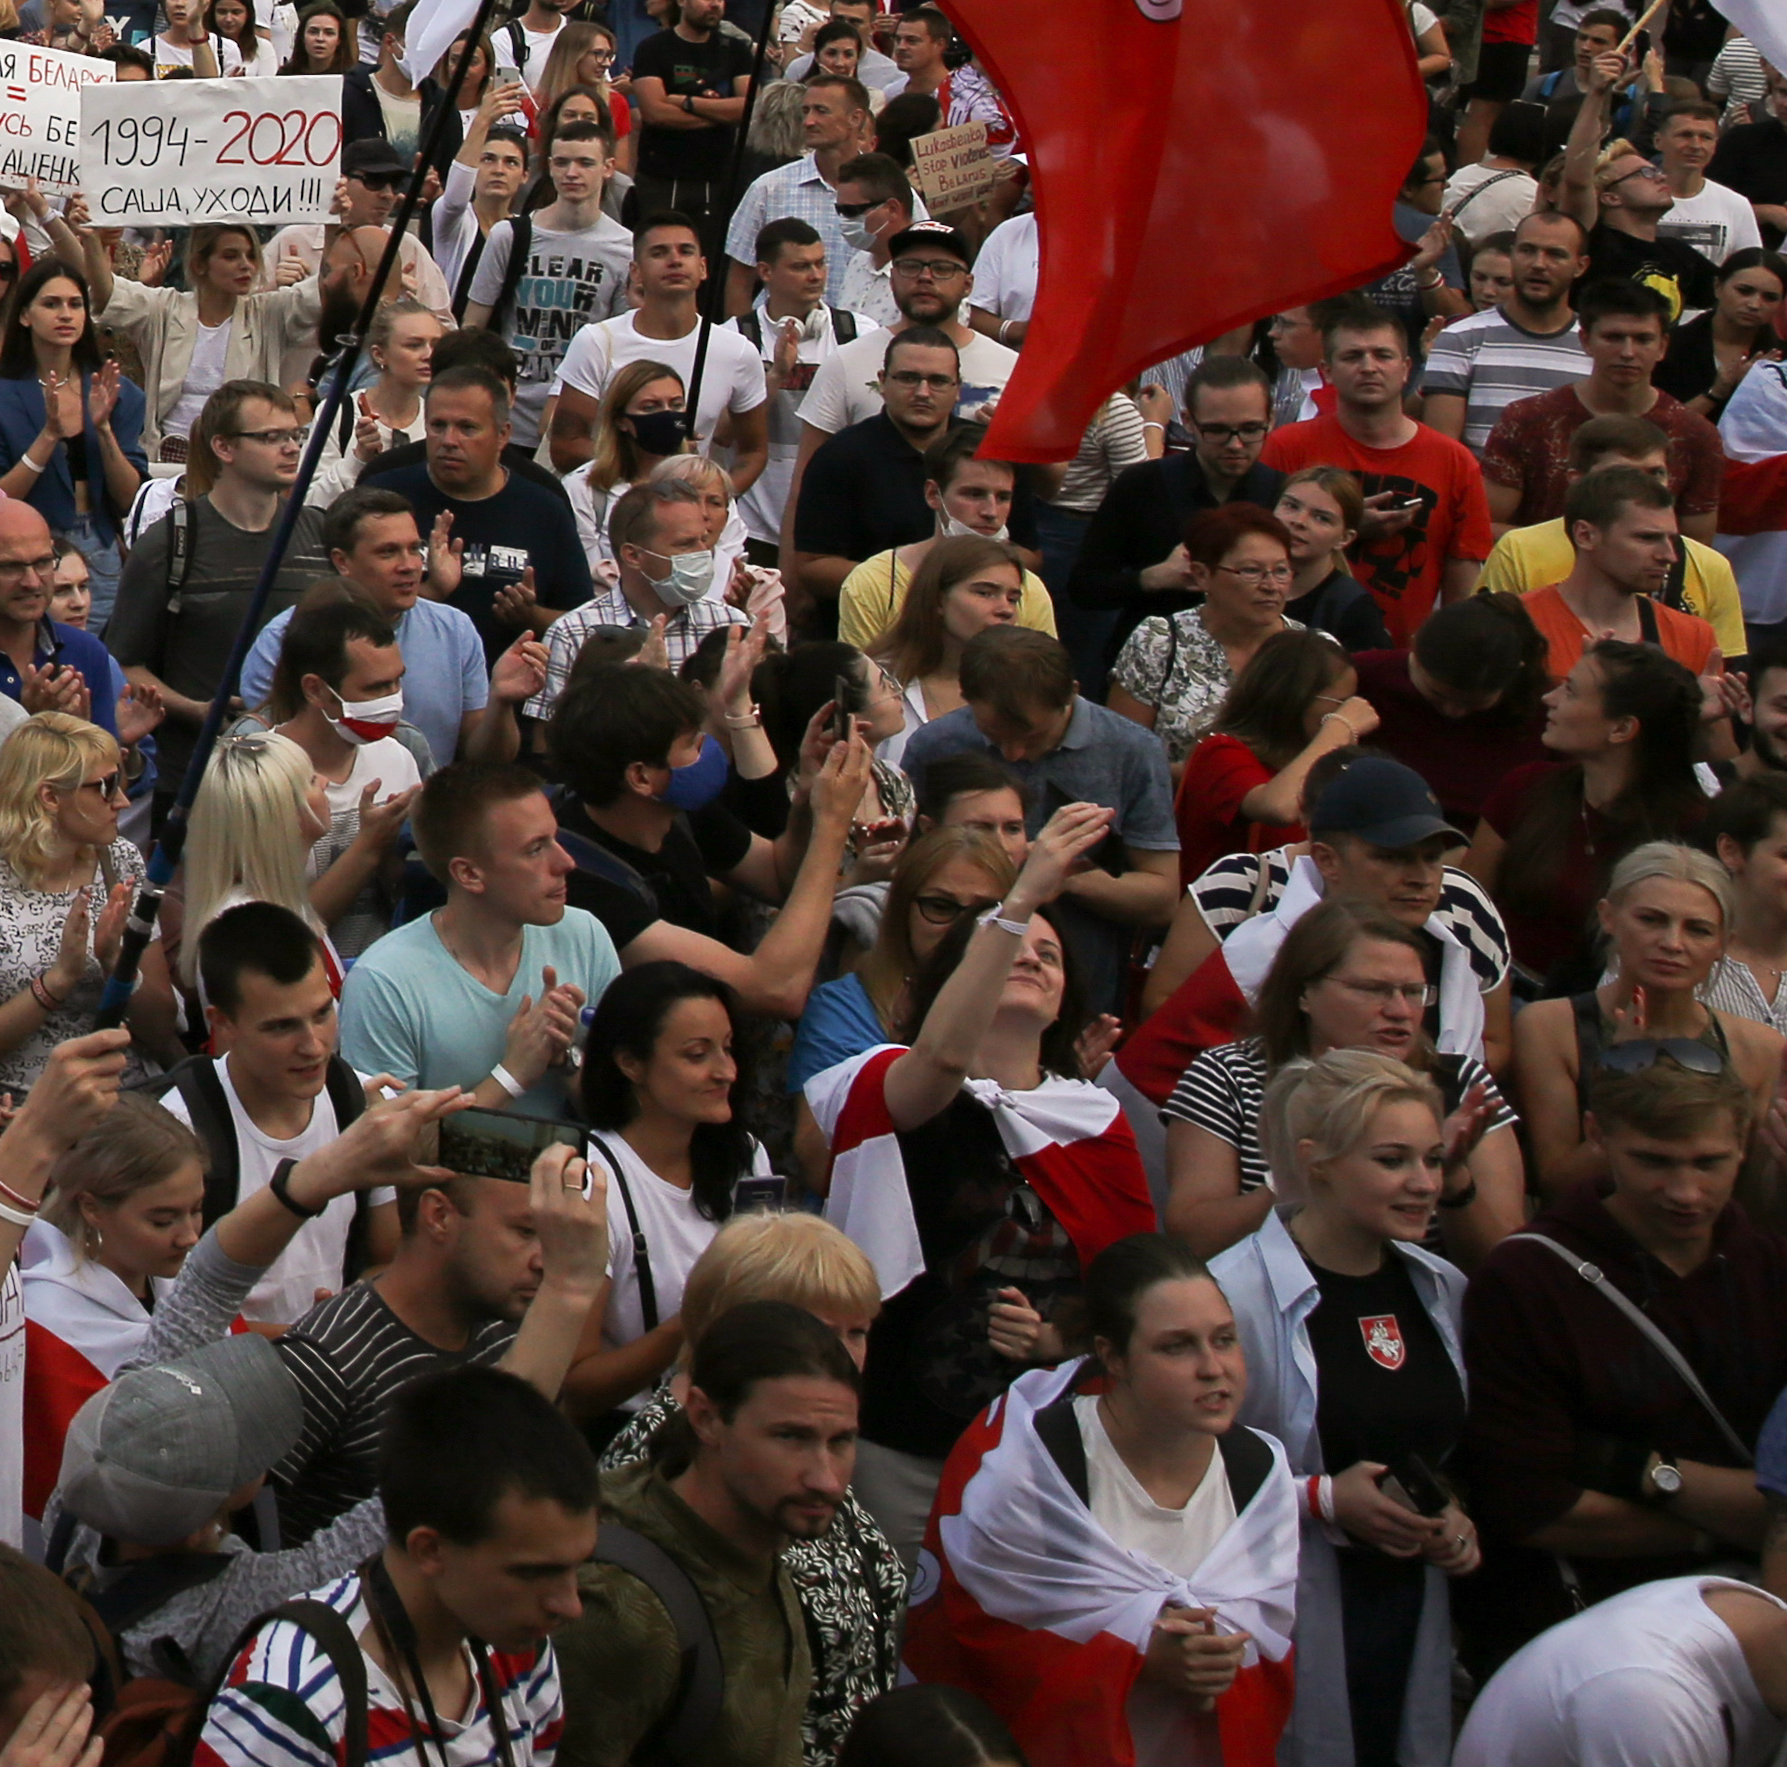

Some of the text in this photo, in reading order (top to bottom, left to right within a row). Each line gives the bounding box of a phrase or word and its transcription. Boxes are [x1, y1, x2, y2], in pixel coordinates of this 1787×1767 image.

[193, 177, 323, 217] УХОДИ!!!
[516, 277, 599, 312] YOUR
[540, 339, 557, 351] OF
